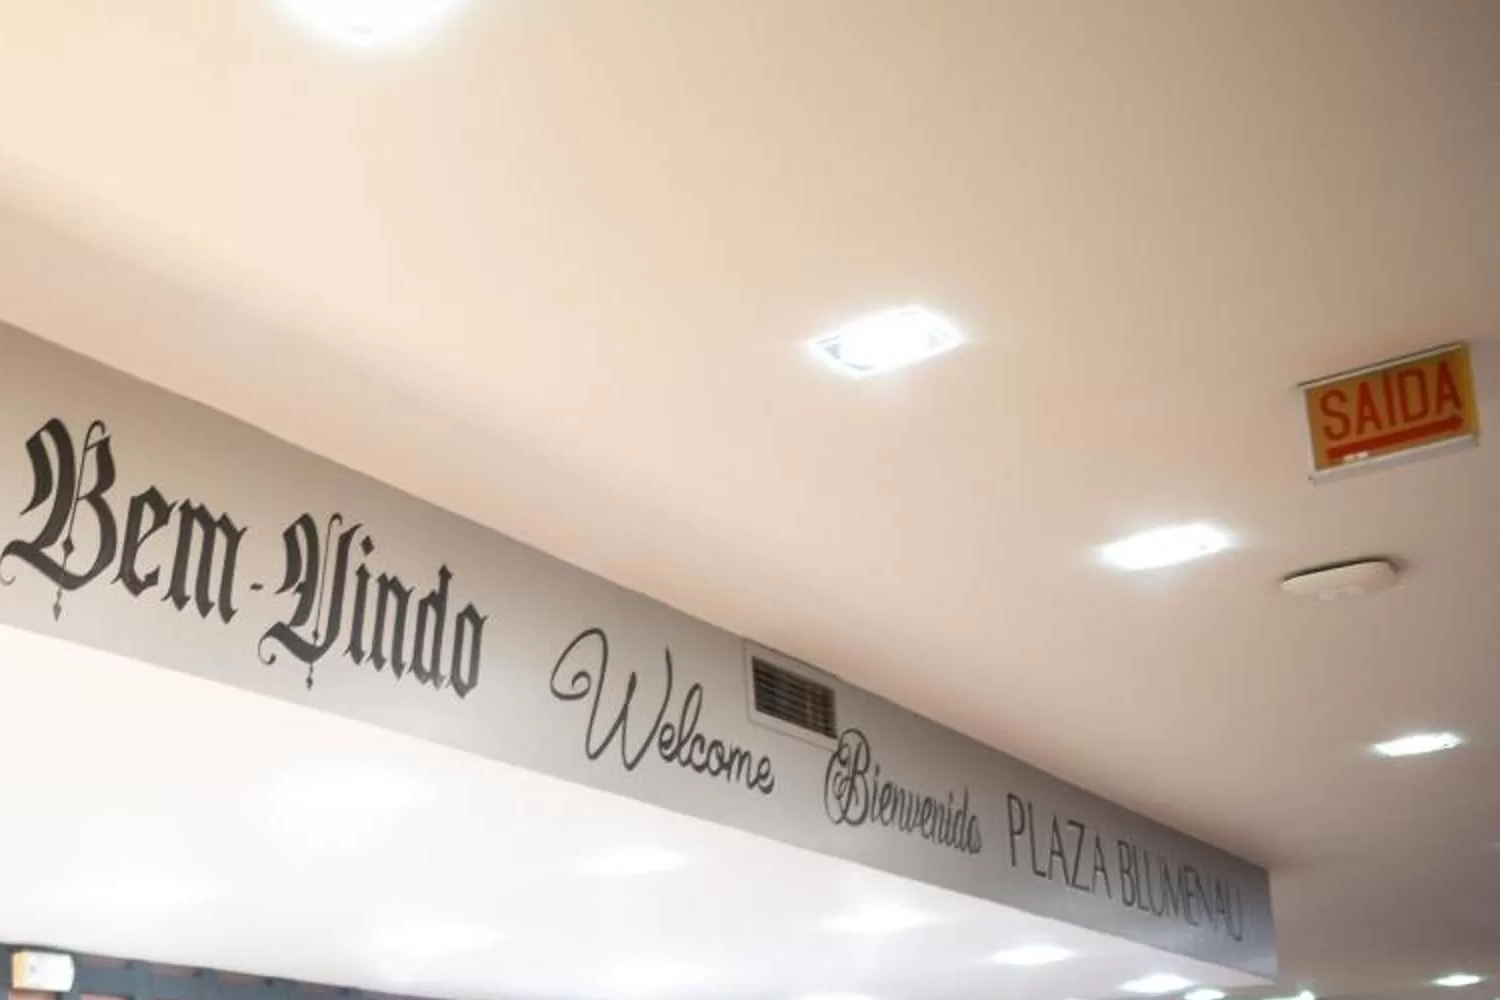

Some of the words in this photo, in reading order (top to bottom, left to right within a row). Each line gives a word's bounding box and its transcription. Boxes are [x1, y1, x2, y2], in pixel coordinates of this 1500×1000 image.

[1320, 360, 1462, 440] SAIDA
[550, 627, 775, 794] Welcome
[825, 728, 982, 854] Bienvenido
[1006, 792, 1113, 900] PLAZA
[1117, 839, 1244, 942] BLUMENAU
